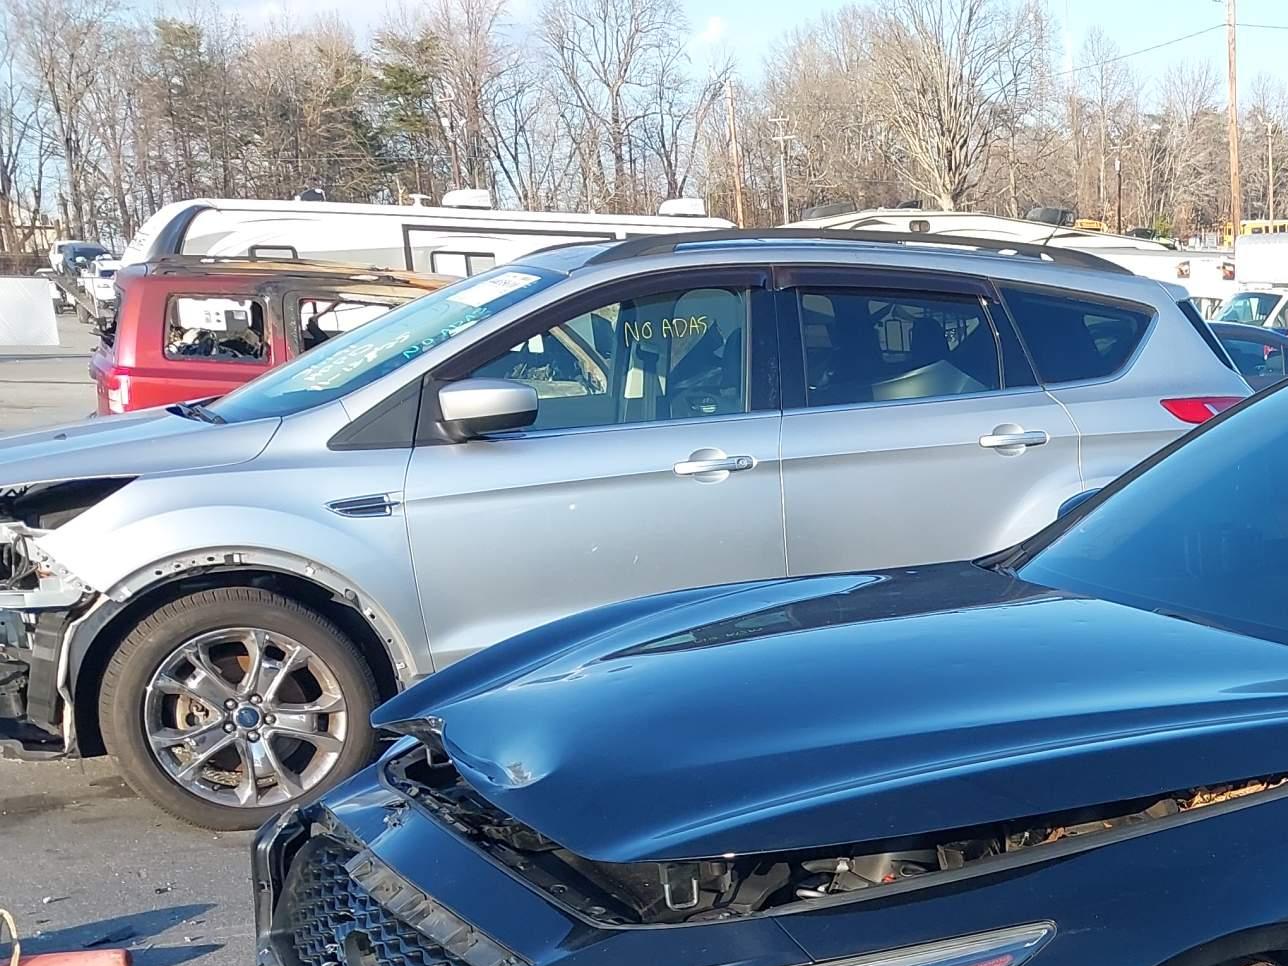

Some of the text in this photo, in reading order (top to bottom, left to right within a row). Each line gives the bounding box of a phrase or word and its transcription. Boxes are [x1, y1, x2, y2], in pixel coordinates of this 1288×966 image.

[624, 315, 708, 348] NO ADAS
[402, 337, 434, 359] NO
